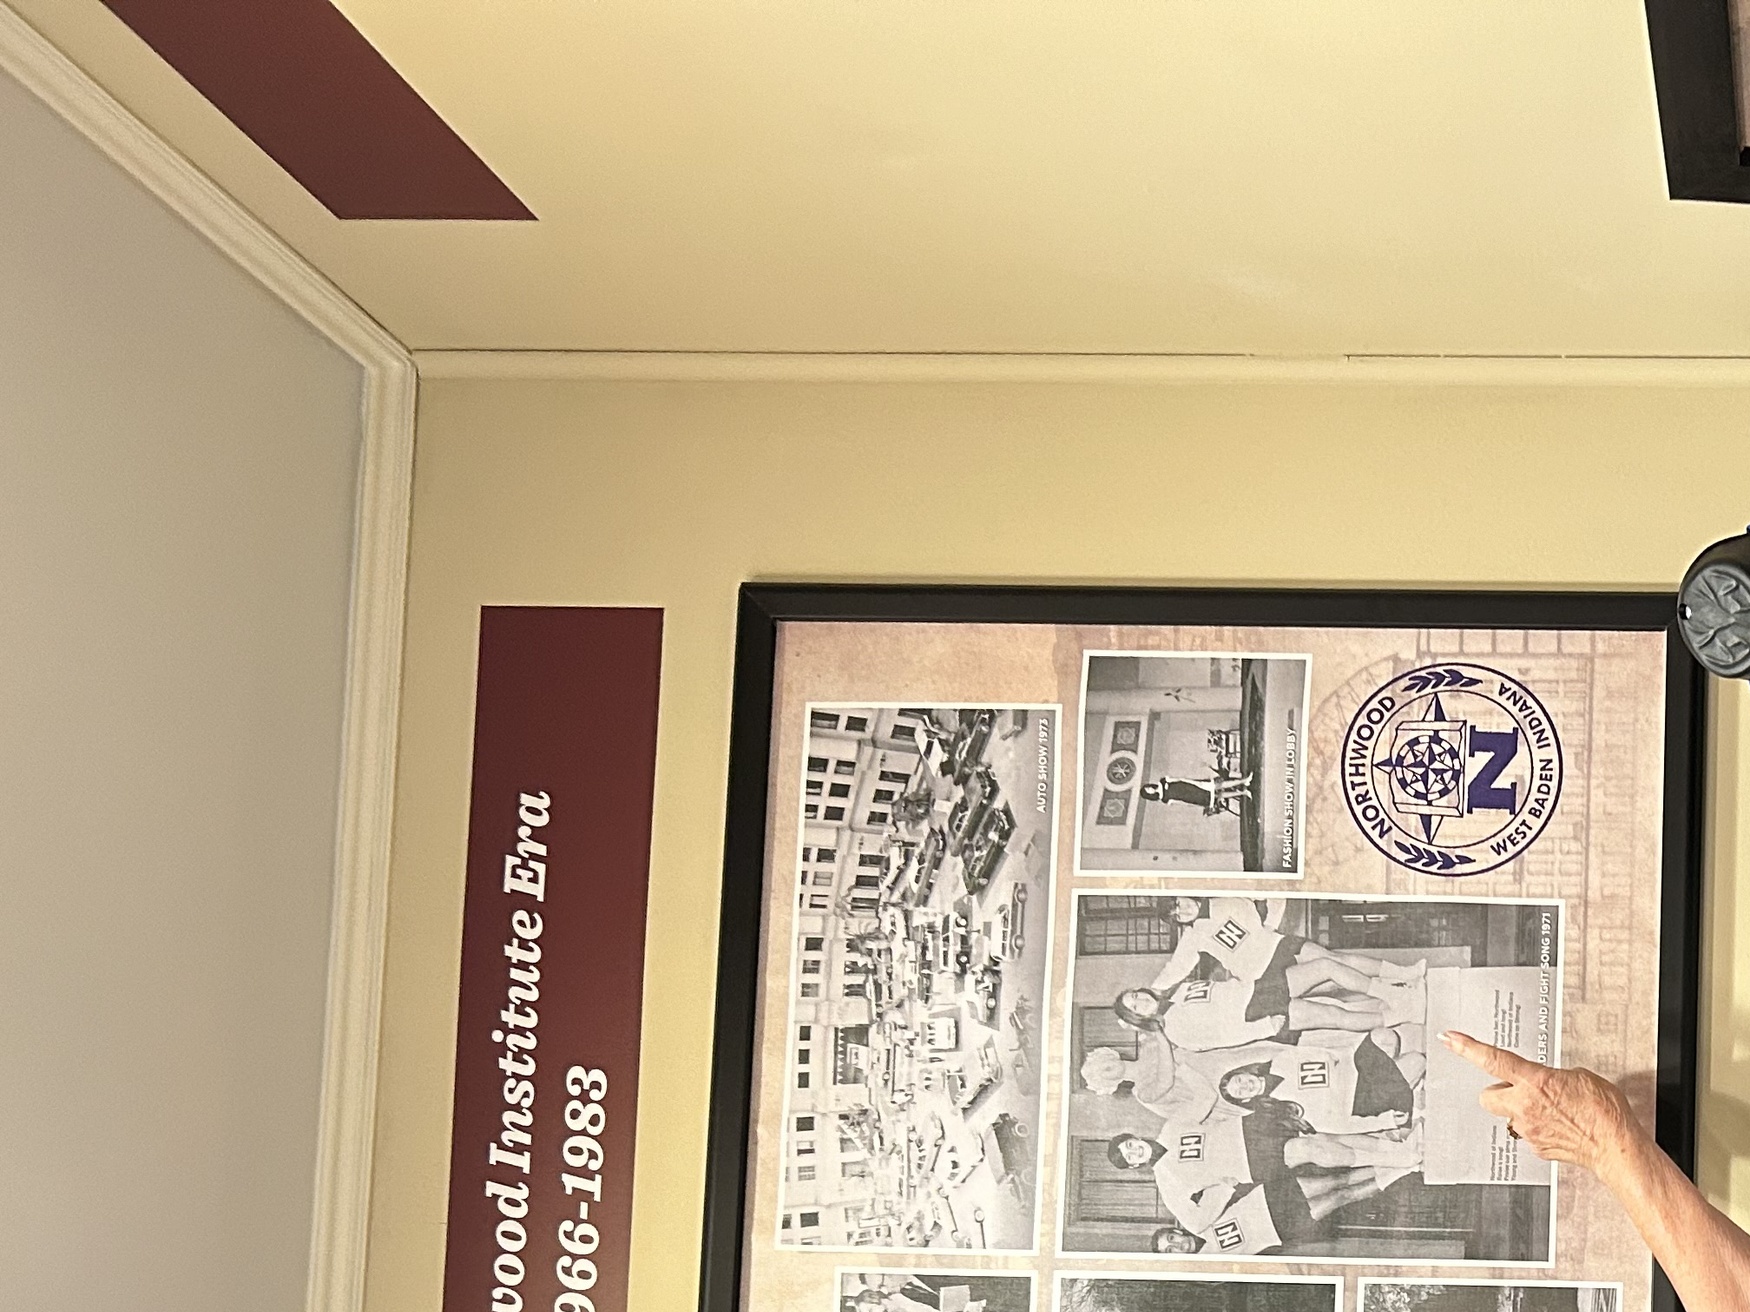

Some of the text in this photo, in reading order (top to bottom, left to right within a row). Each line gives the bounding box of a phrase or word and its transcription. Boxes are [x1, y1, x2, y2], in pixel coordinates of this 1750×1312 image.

[1037, 718, 1048, 813] AUTO SHOW 1973
[1282, 728, 1296, 868] FASHION SHOW IN LOBBY
[1349, 696, 1396, 839] NORTHWOOD
[1467, 725, 1518, 815] N
[1490, 682, 1553, 856] WEST BADEN INDIANA
[1537, 912, 1550, 1066] DERS AND FIGHT SONG 1971
